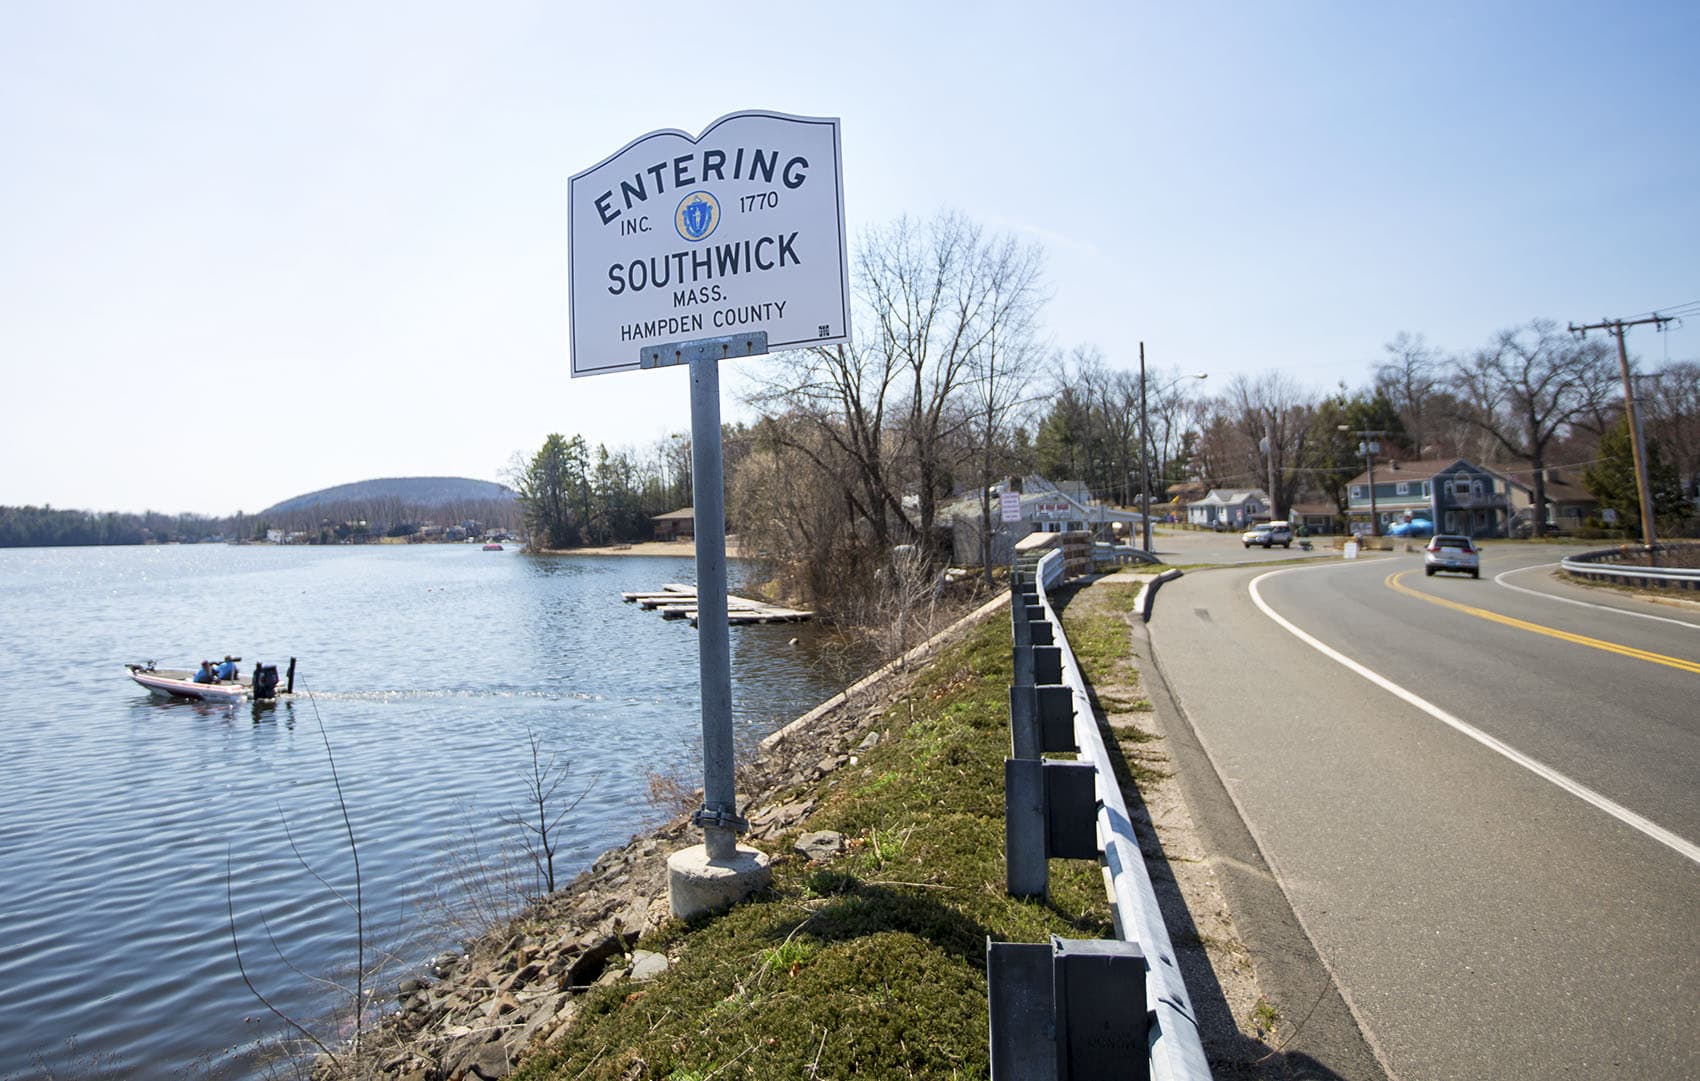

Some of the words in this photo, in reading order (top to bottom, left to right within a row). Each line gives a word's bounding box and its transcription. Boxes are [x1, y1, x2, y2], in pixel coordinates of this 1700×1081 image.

[594, 147, 809, 226] ENTERING
[621, 216, 652, 236] INC.
[739, 191, 779, 213] 1770
[607, 231, 801, 296] SOUTHWICK
[673, 284, 727, 308] MASS.
[621, 313, 703, 342] HAMPDEN
[713, 300, 787, 328] COUNTY
